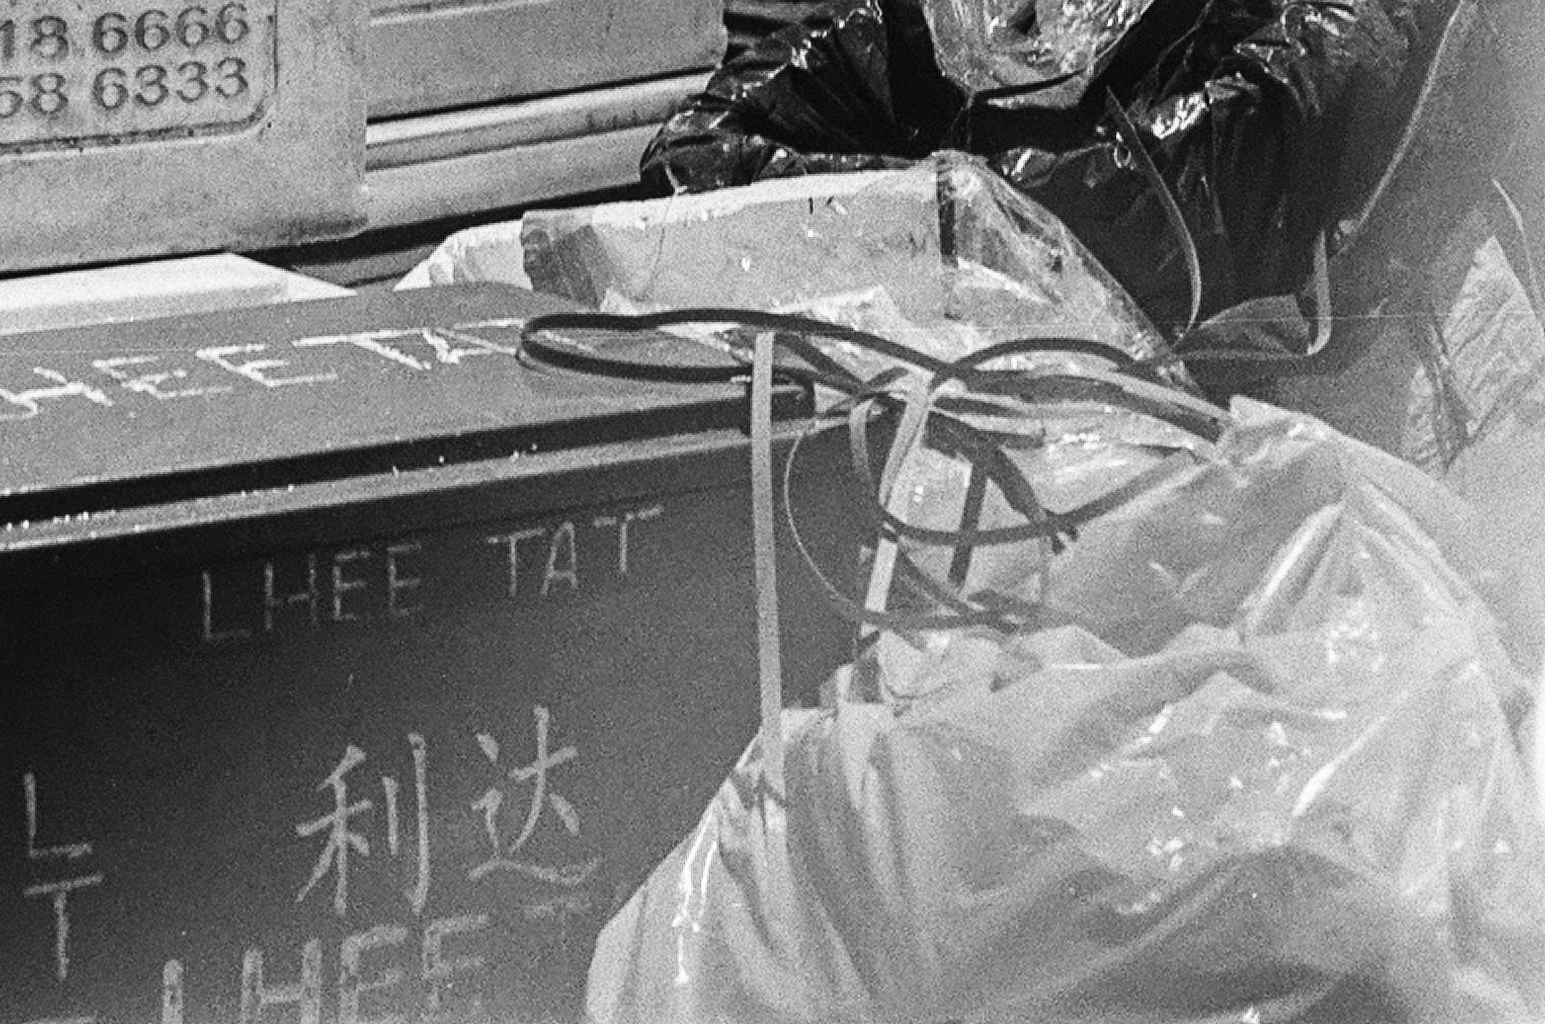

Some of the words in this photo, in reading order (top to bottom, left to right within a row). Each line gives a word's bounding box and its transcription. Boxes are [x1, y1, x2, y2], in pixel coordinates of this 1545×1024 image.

[92, 2, 251, 56] 6666
[92, 58, 250, 111] 6333
[202, 545, 423, 640] LHEE
[487, 505, 663, 597] TAT
[294, 705, 602, 915] 利达
